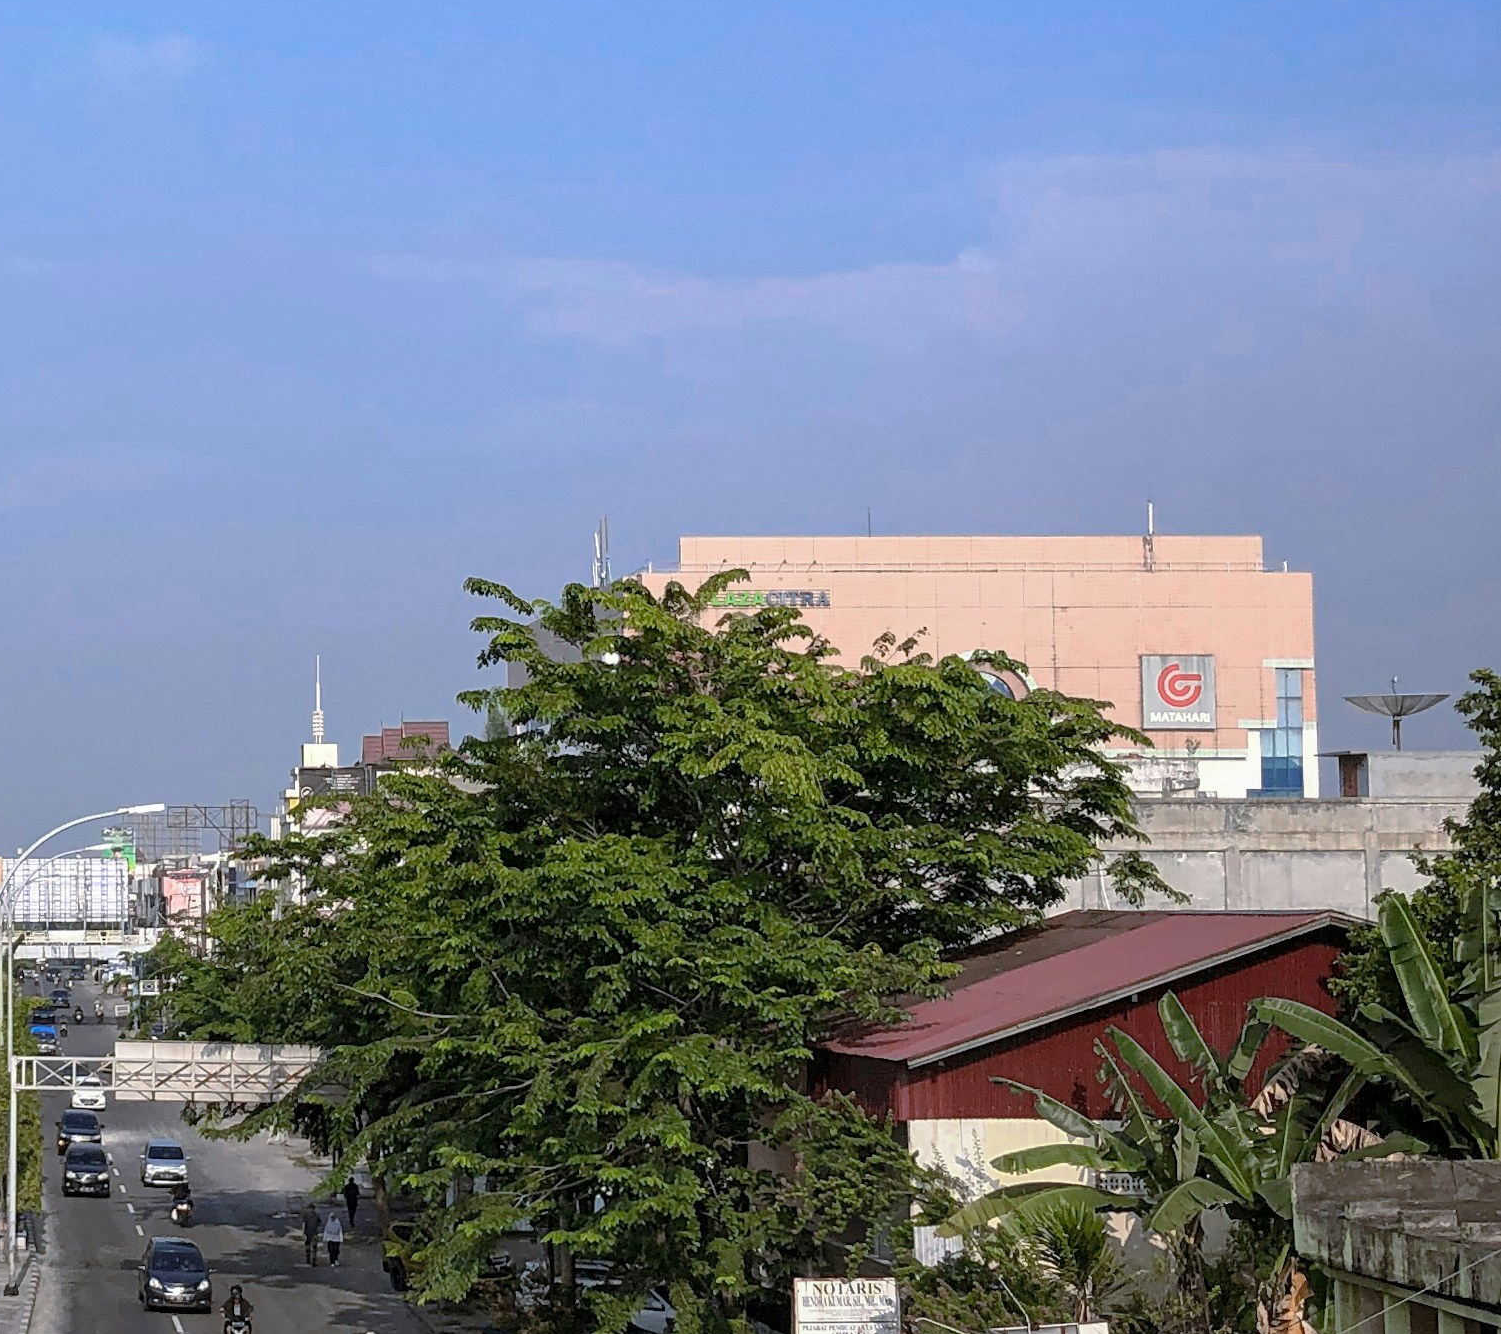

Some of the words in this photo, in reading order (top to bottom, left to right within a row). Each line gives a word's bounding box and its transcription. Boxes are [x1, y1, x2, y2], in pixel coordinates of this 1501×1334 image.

[708, 590, 765, 607] LAZA
[1150, 712, 1211, 723] MATAHARI
[813, 1282, 882, 1295] NOTARIS
